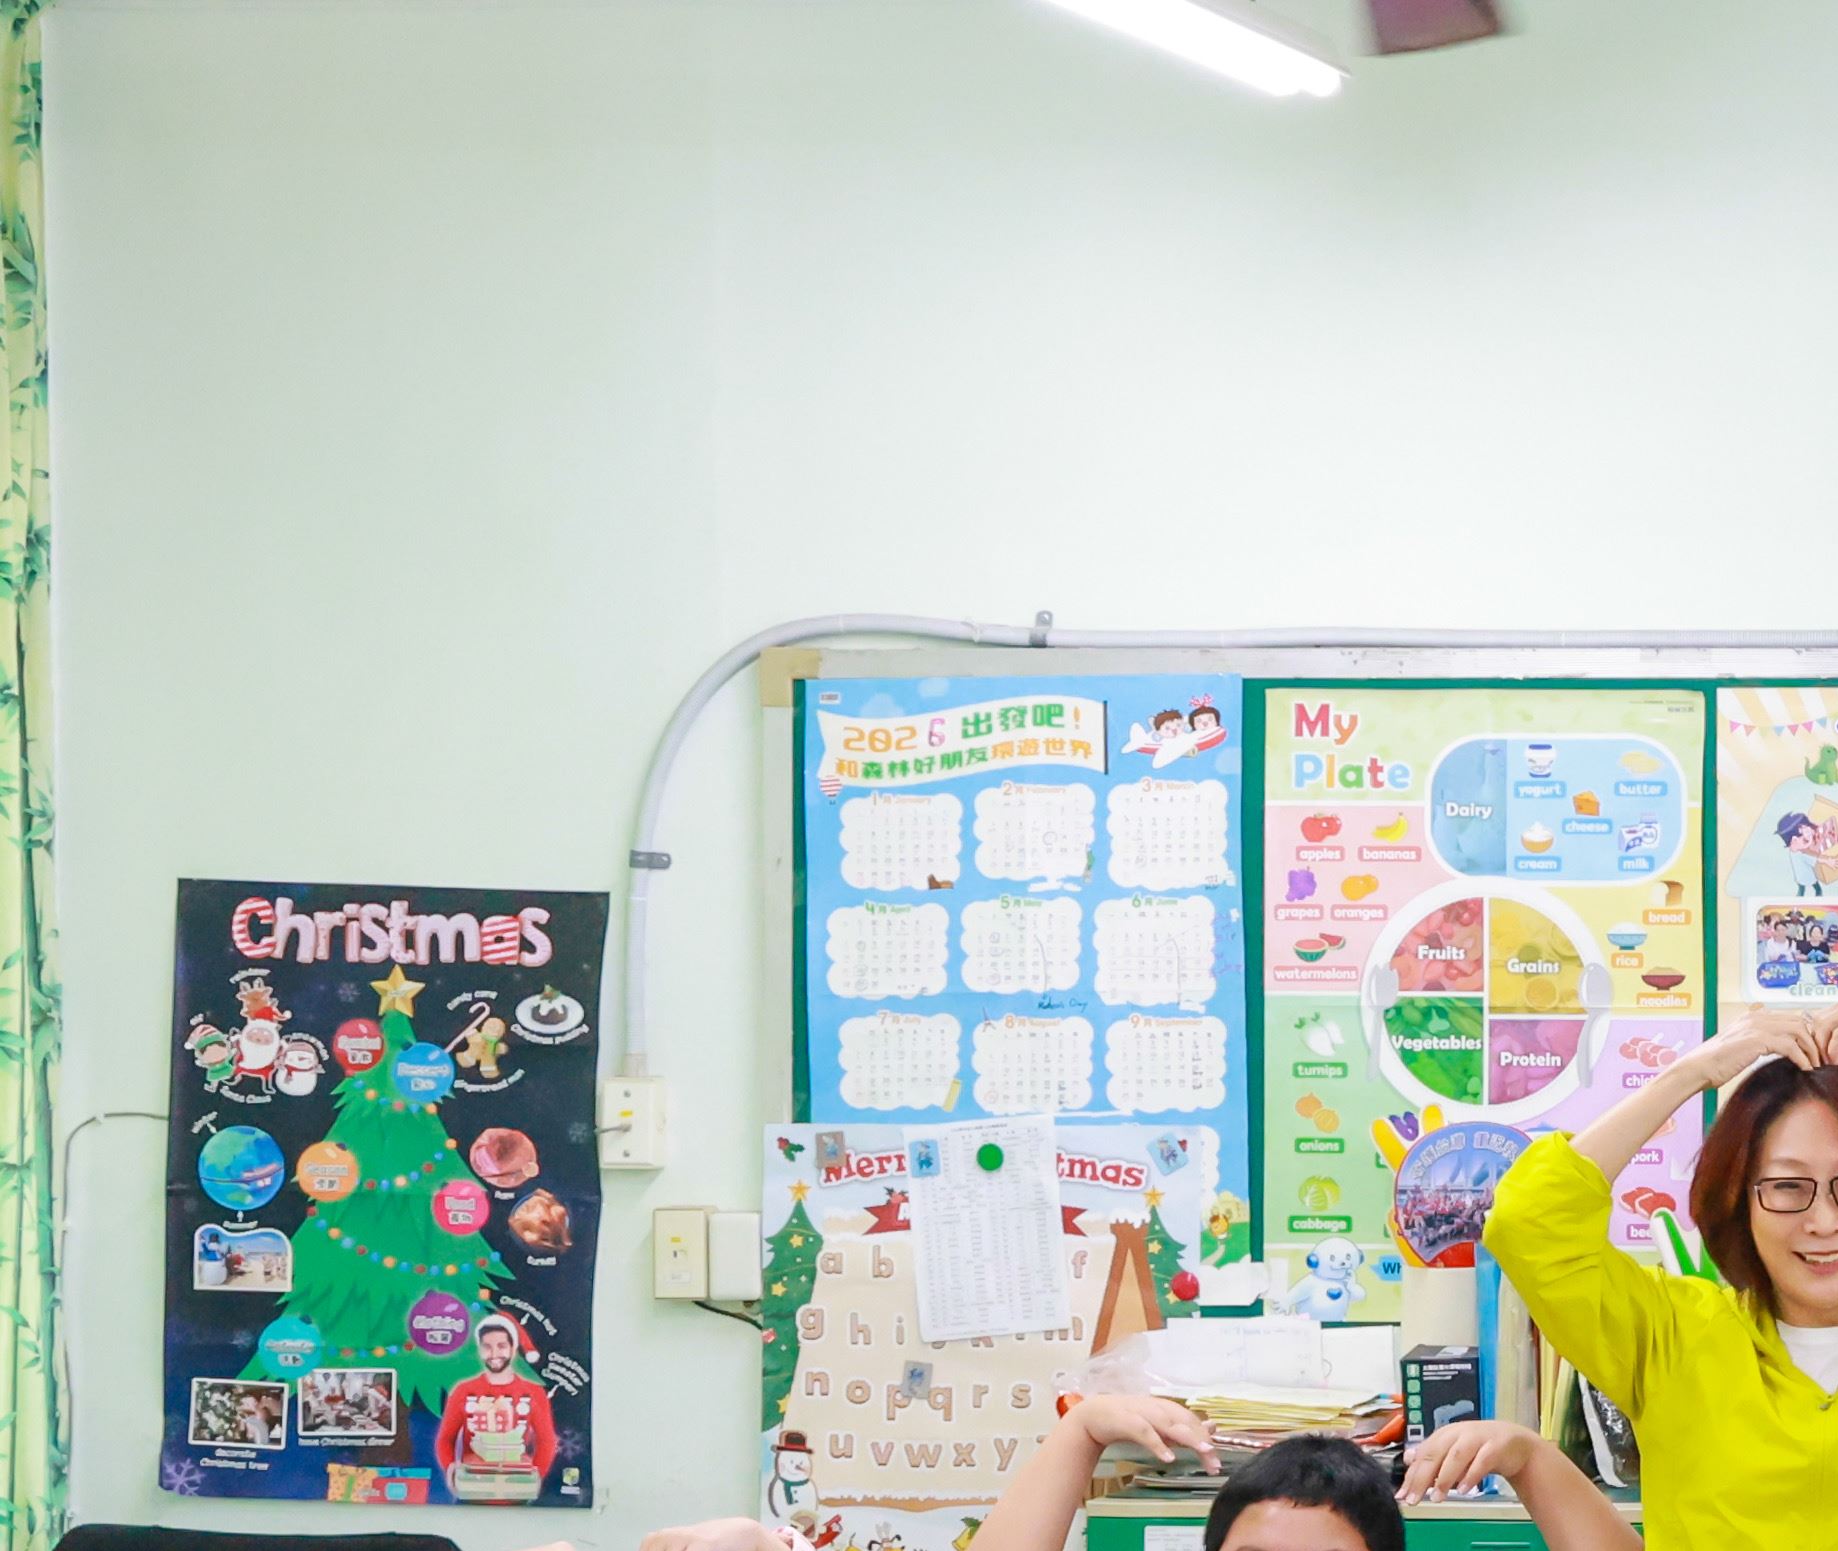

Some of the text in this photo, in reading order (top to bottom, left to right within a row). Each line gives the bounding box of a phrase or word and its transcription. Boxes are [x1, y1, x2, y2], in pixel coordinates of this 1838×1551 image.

[1293, 702, 1359, 745] My
[1293, 753, 1411, 790] Plate
[1517, 783, 1562, 798] yogurt
[1619, 782, 1662, 797] butter
[1446, 801, 1492, 820] Dairy
[1565, 821, 1609, 833] cheese
[1299, 848, 1341, 862] apples
[1362, 847, 1417, 861] bananas
[1518, 858, 1558, 870] cream
[1623, 856, 1649, 869] milk
[1276, 906, 1320, 920] grapes
[1333, 906, 1384, 920] oranges
[1649, 911, 1685, 924] bread
[231, 896, 553, 967] Christmas
[1417, 944, 1466, 960] Fruits
[1507, 958, 1560, 974] Grains
[1616, 954, 1639, 967] rice
[1274, 968, 1357, 981] watermelons
[1789, 983, 1837, 997] clean
[1640, 995, 1688, 1008] noodles
[1392, 1035, 1483, 1053] Vegetables
[1500, 1052, 1561, 1067] Protein
[1297, 1065, 1343, 1079] turnips
[1299, 1140, 1340, 1153] onions
[823, 1151, 905, 1184] Merr
[1292, 1216, 1347, 1231] cabbage
[1631, 1225, 1653, 1238] bee
[820, 1245, 1088, 1278] a b f
[800, 1308, 904, 1345] g h i
[805, 1370, 1032, 1421] n o p q r s
[829, 1434, 1018, 1471] u v w x y
